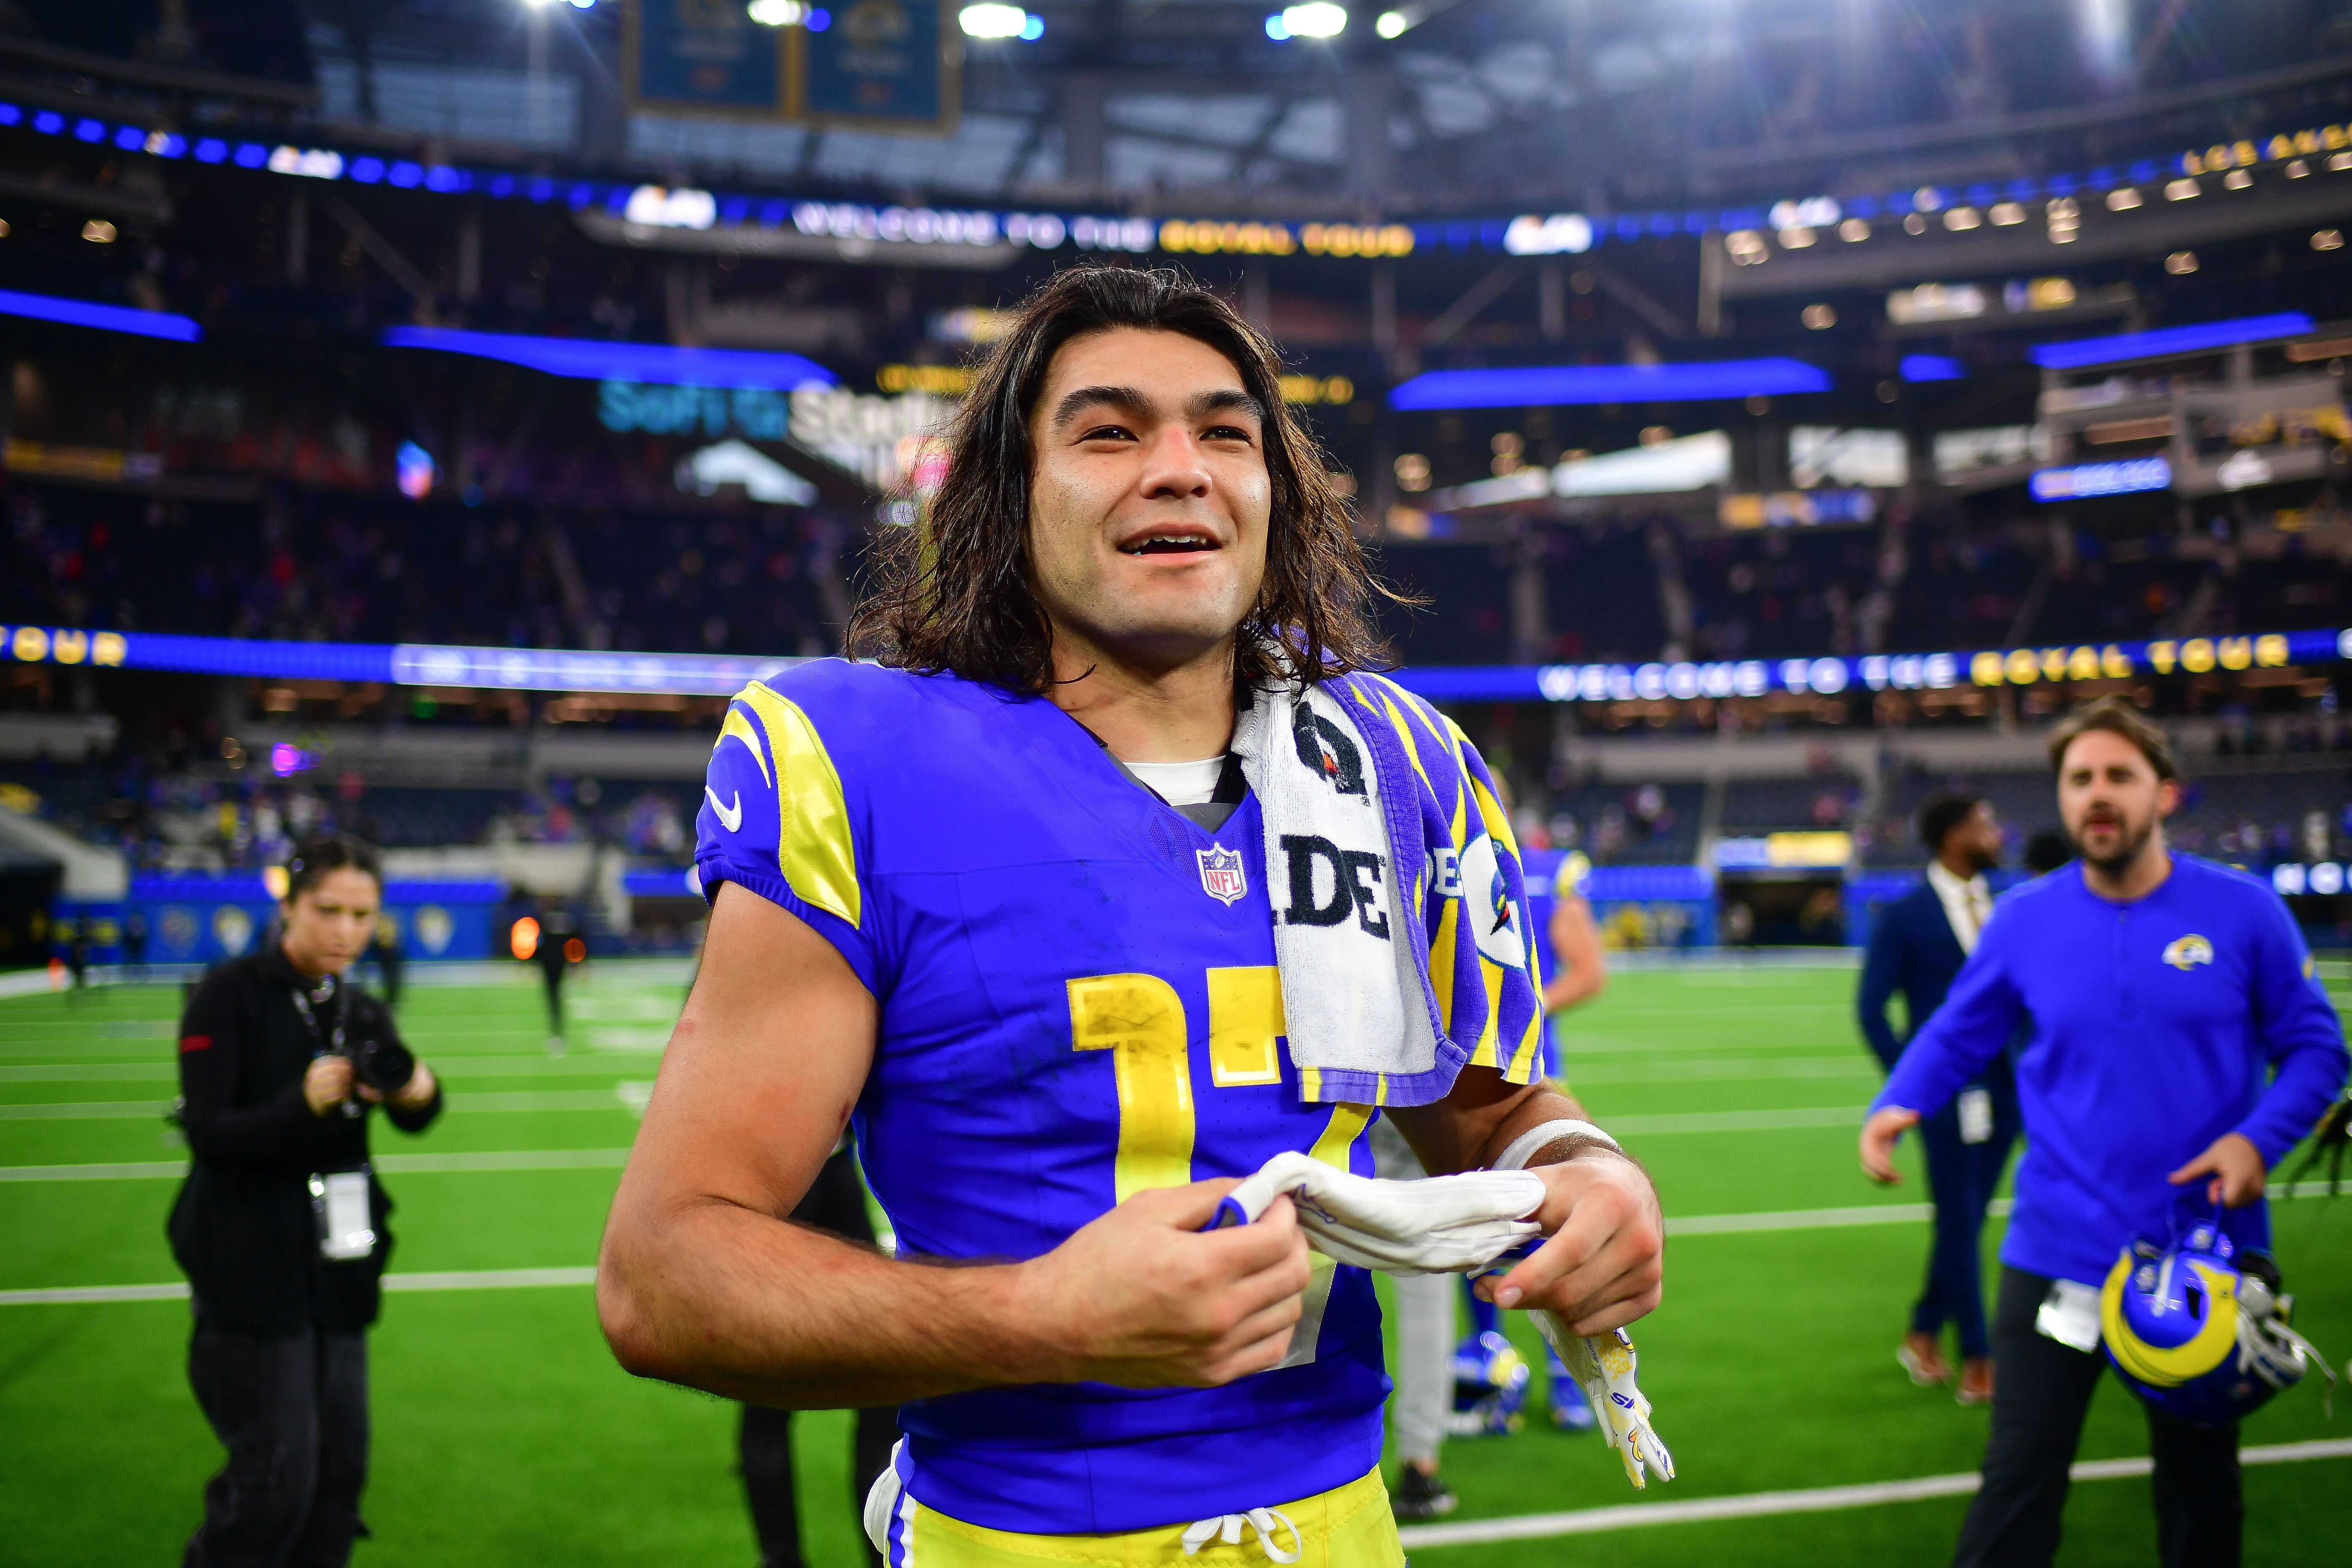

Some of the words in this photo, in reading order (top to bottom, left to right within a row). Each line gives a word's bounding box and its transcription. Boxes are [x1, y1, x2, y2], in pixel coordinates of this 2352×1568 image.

[792, 202, 999, 246] WELCOME
[1004, 212, 1066, 249] TO
[1160, 219, 1298, 256] ROYAL
[0, 626, 127, 667] OUR
[1538, 660, 1769, 701] WELCOME
[1778, 656, 1848, 694] TO
[1861, 653, 1957, 691] THE
[1970, 644, 2133, 687] ROYAL
[2147, 633, 2289, 675] TOUR
[1208, 871, 1240, 893] NFL
[1271, 834, 1391, 941] DE
